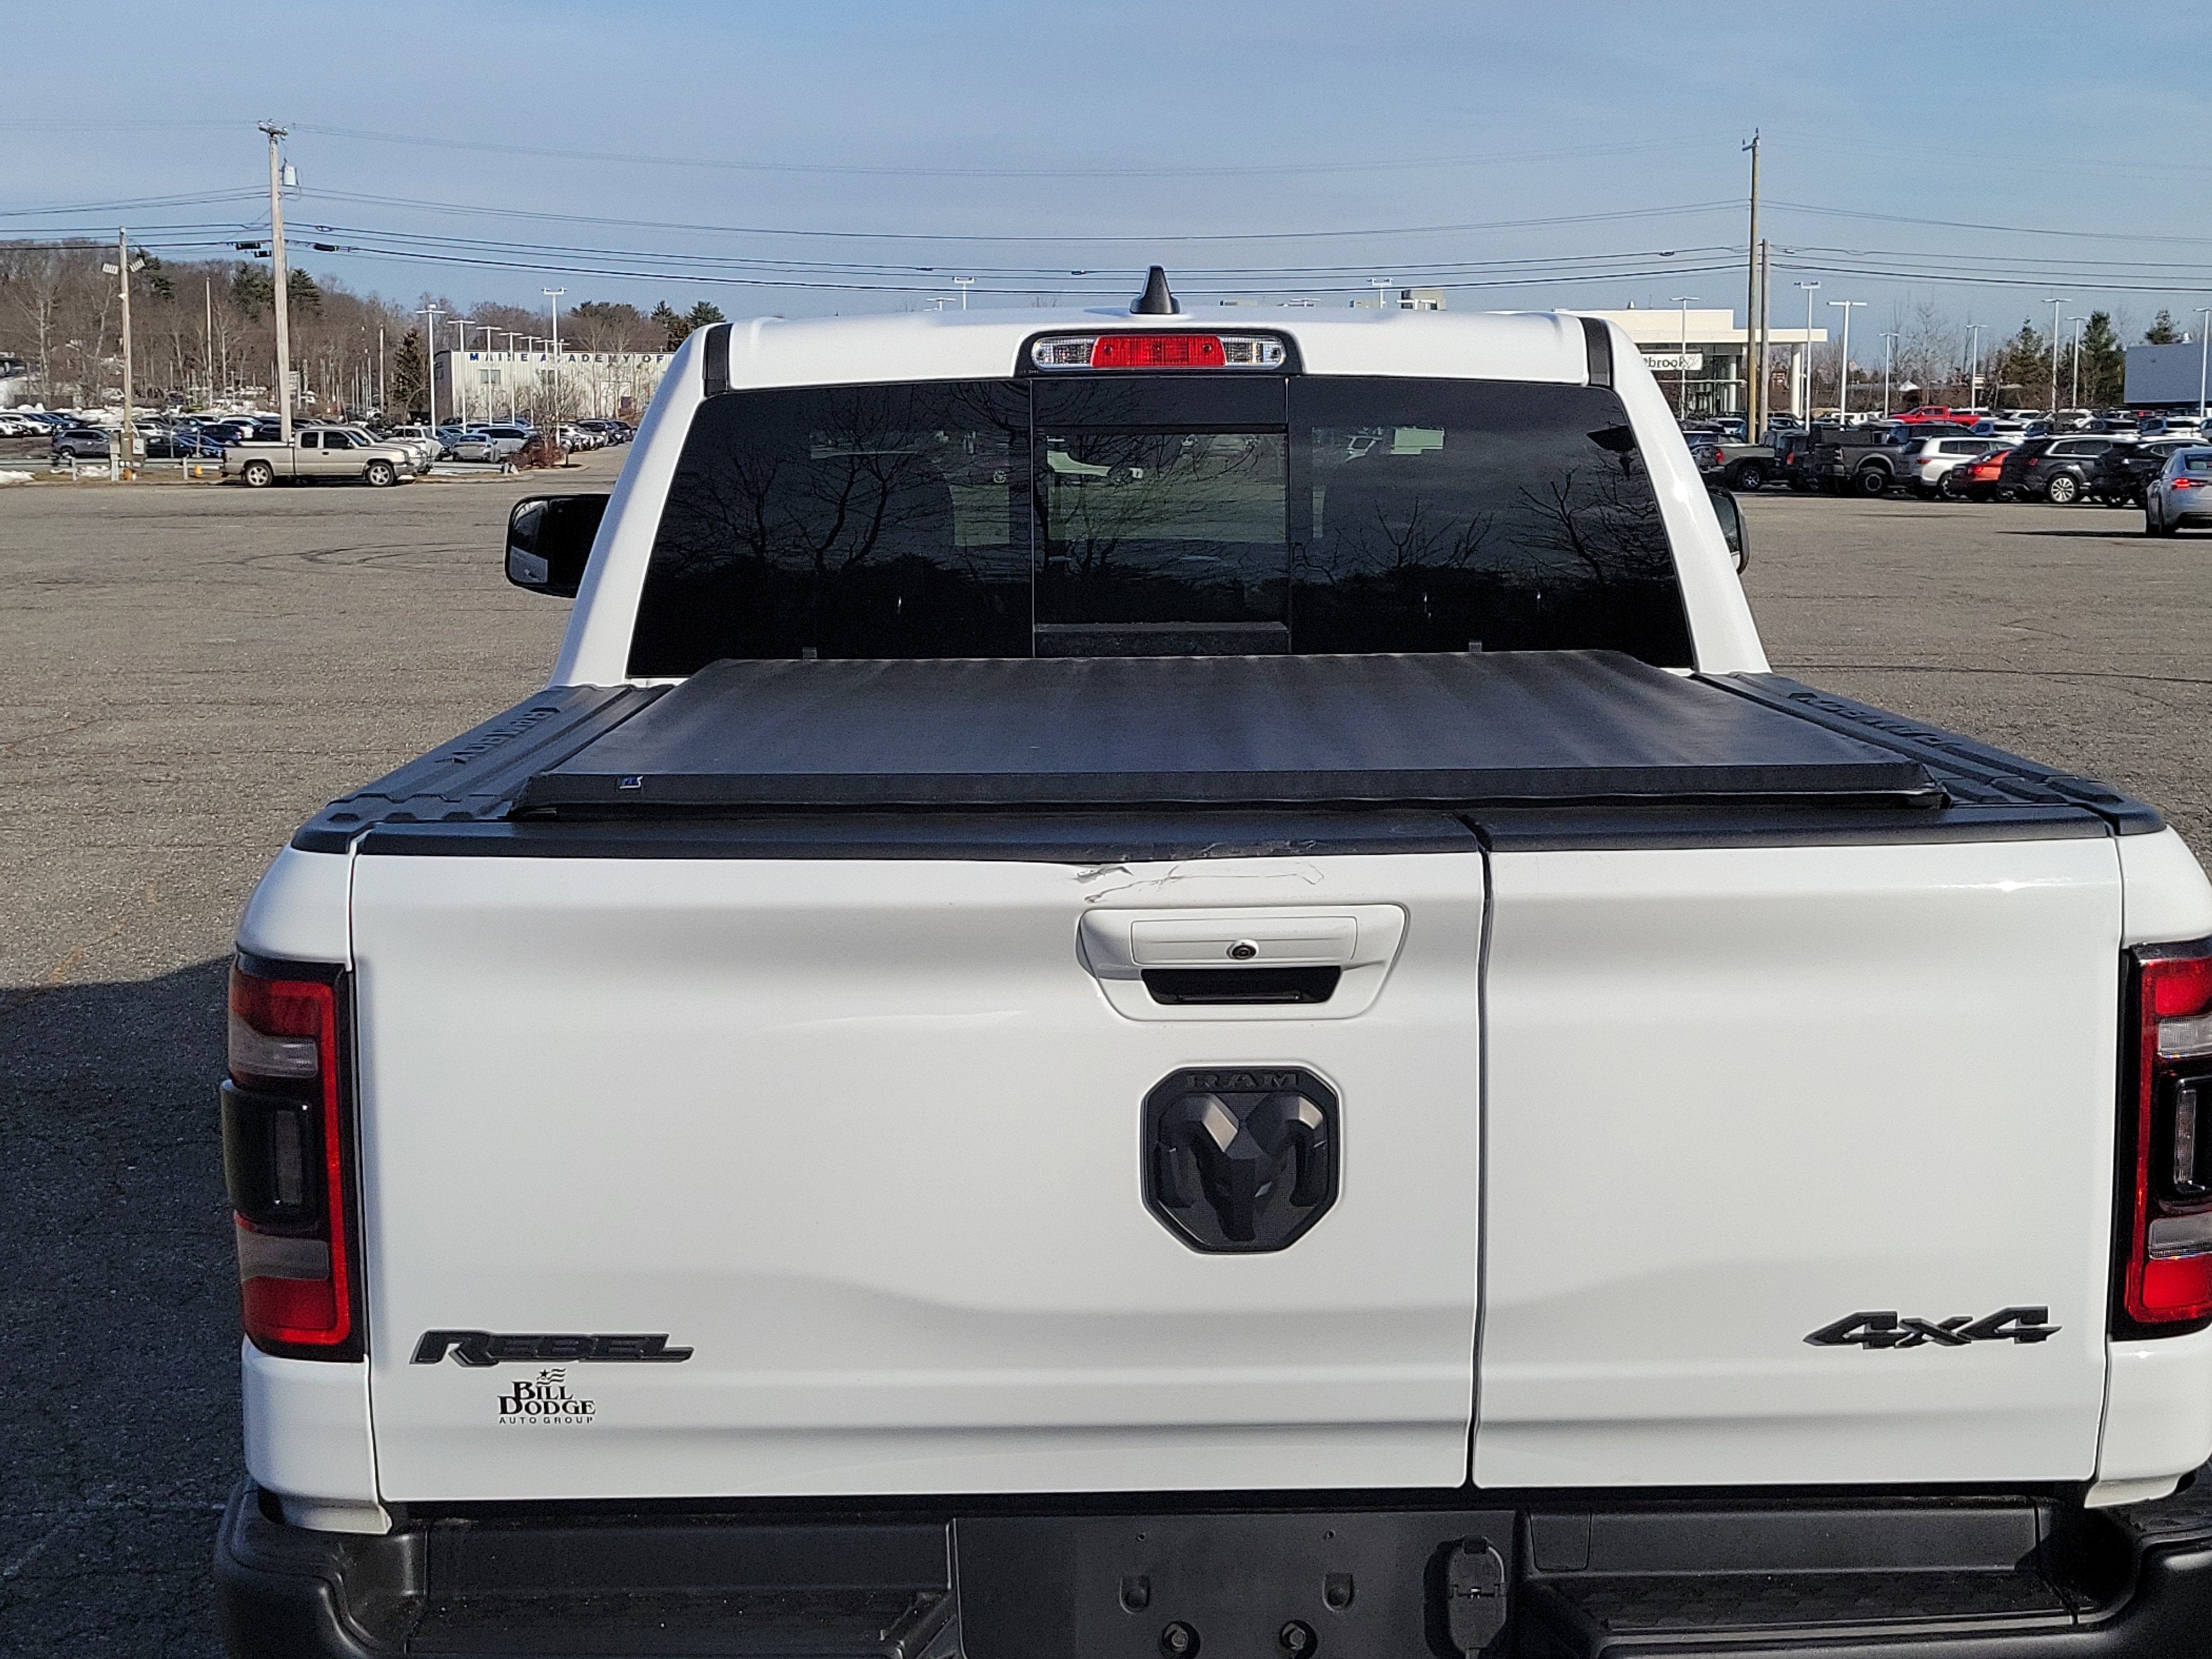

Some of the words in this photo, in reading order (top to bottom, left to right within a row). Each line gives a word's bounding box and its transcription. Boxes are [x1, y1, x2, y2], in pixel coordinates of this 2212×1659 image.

[539, 353, 631, 363] AADEMY
[642, 354, 664, 363] OF
[1186, 1074, 1298, 1088] RAM
[409, 1329, 693, 1367] REBEL
[497, 1395, 596, 1415] DODGE
